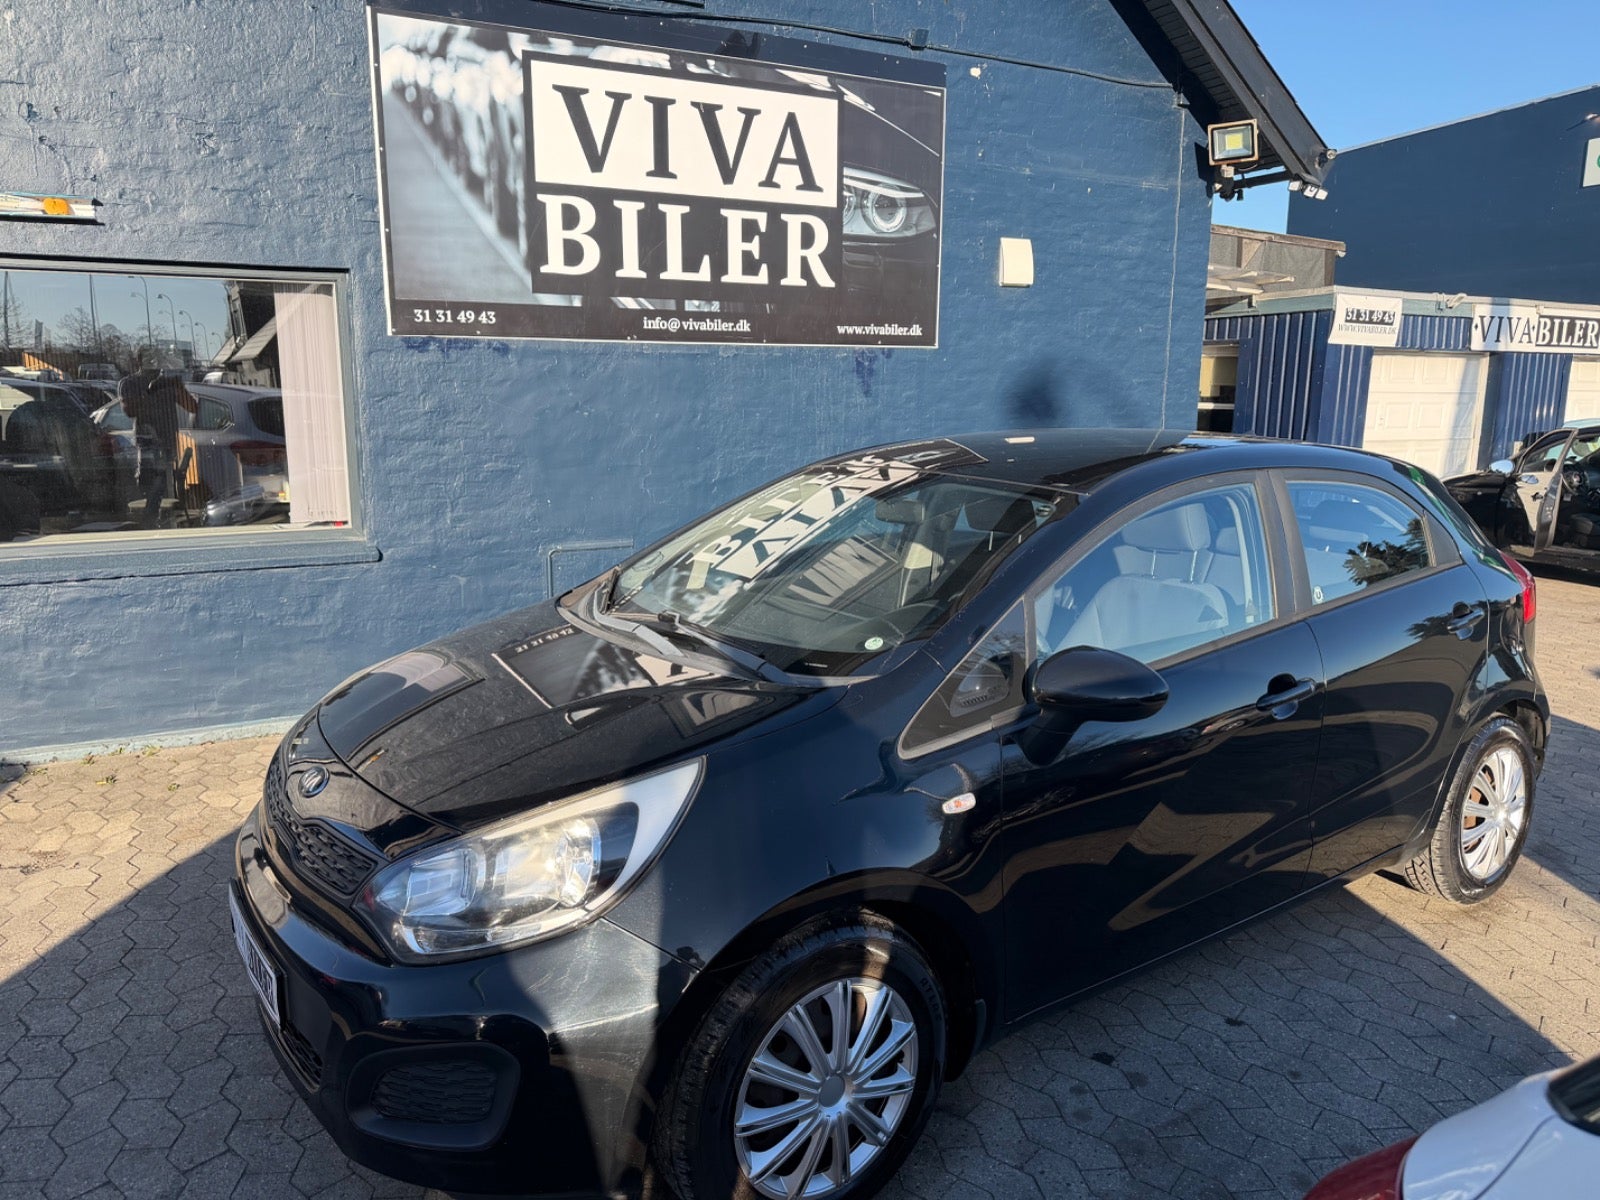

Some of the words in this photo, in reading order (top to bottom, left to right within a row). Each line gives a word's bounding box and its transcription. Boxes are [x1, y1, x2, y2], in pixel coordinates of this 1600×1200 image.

[552, 83, 824, 193] VIVA
[536, 193, 836, 288] BILER
[413, 308, 432, 323] 31
[435, 309, 454, 323] 31
[456, 310, 475, 324] 49
[478, 310, 497, 325] 43
[1359, 309, 1370, 322] 31
[1371, 309, 1383, 323] 49
[836, 323, 923, 336] www.vivabiler.dk
[1478, 315, 1534, 344] VIVA
[1537, 317, 1599, 348] BILER
